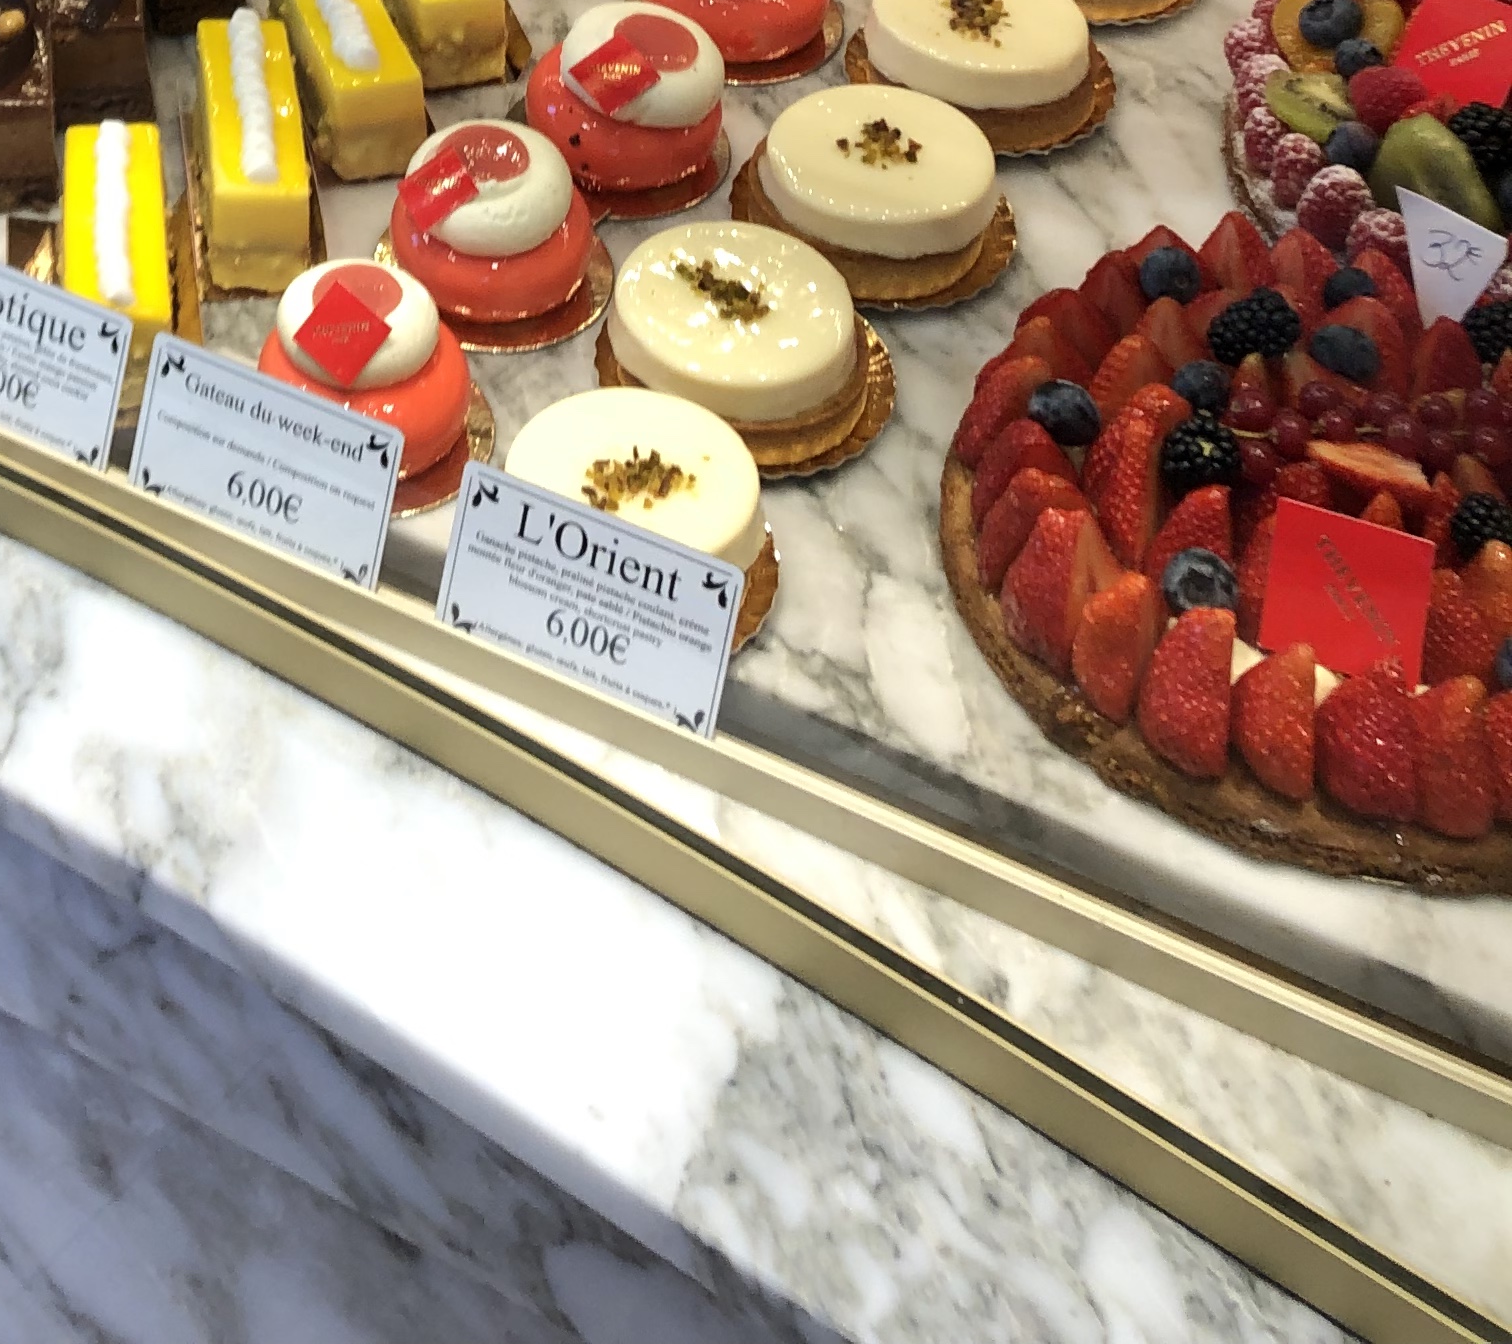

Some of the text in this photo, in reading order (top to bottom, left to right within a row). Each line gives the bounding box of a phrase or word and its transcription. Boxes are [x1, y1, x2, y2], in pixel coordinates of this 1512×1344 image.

[1414, 19, 1507, 66] THEVENIN
[227, 471, 302, 523] 6,00€
[517, 503, 681, 601] L'Orient
[546, 609, 630, 664] 6,00€
